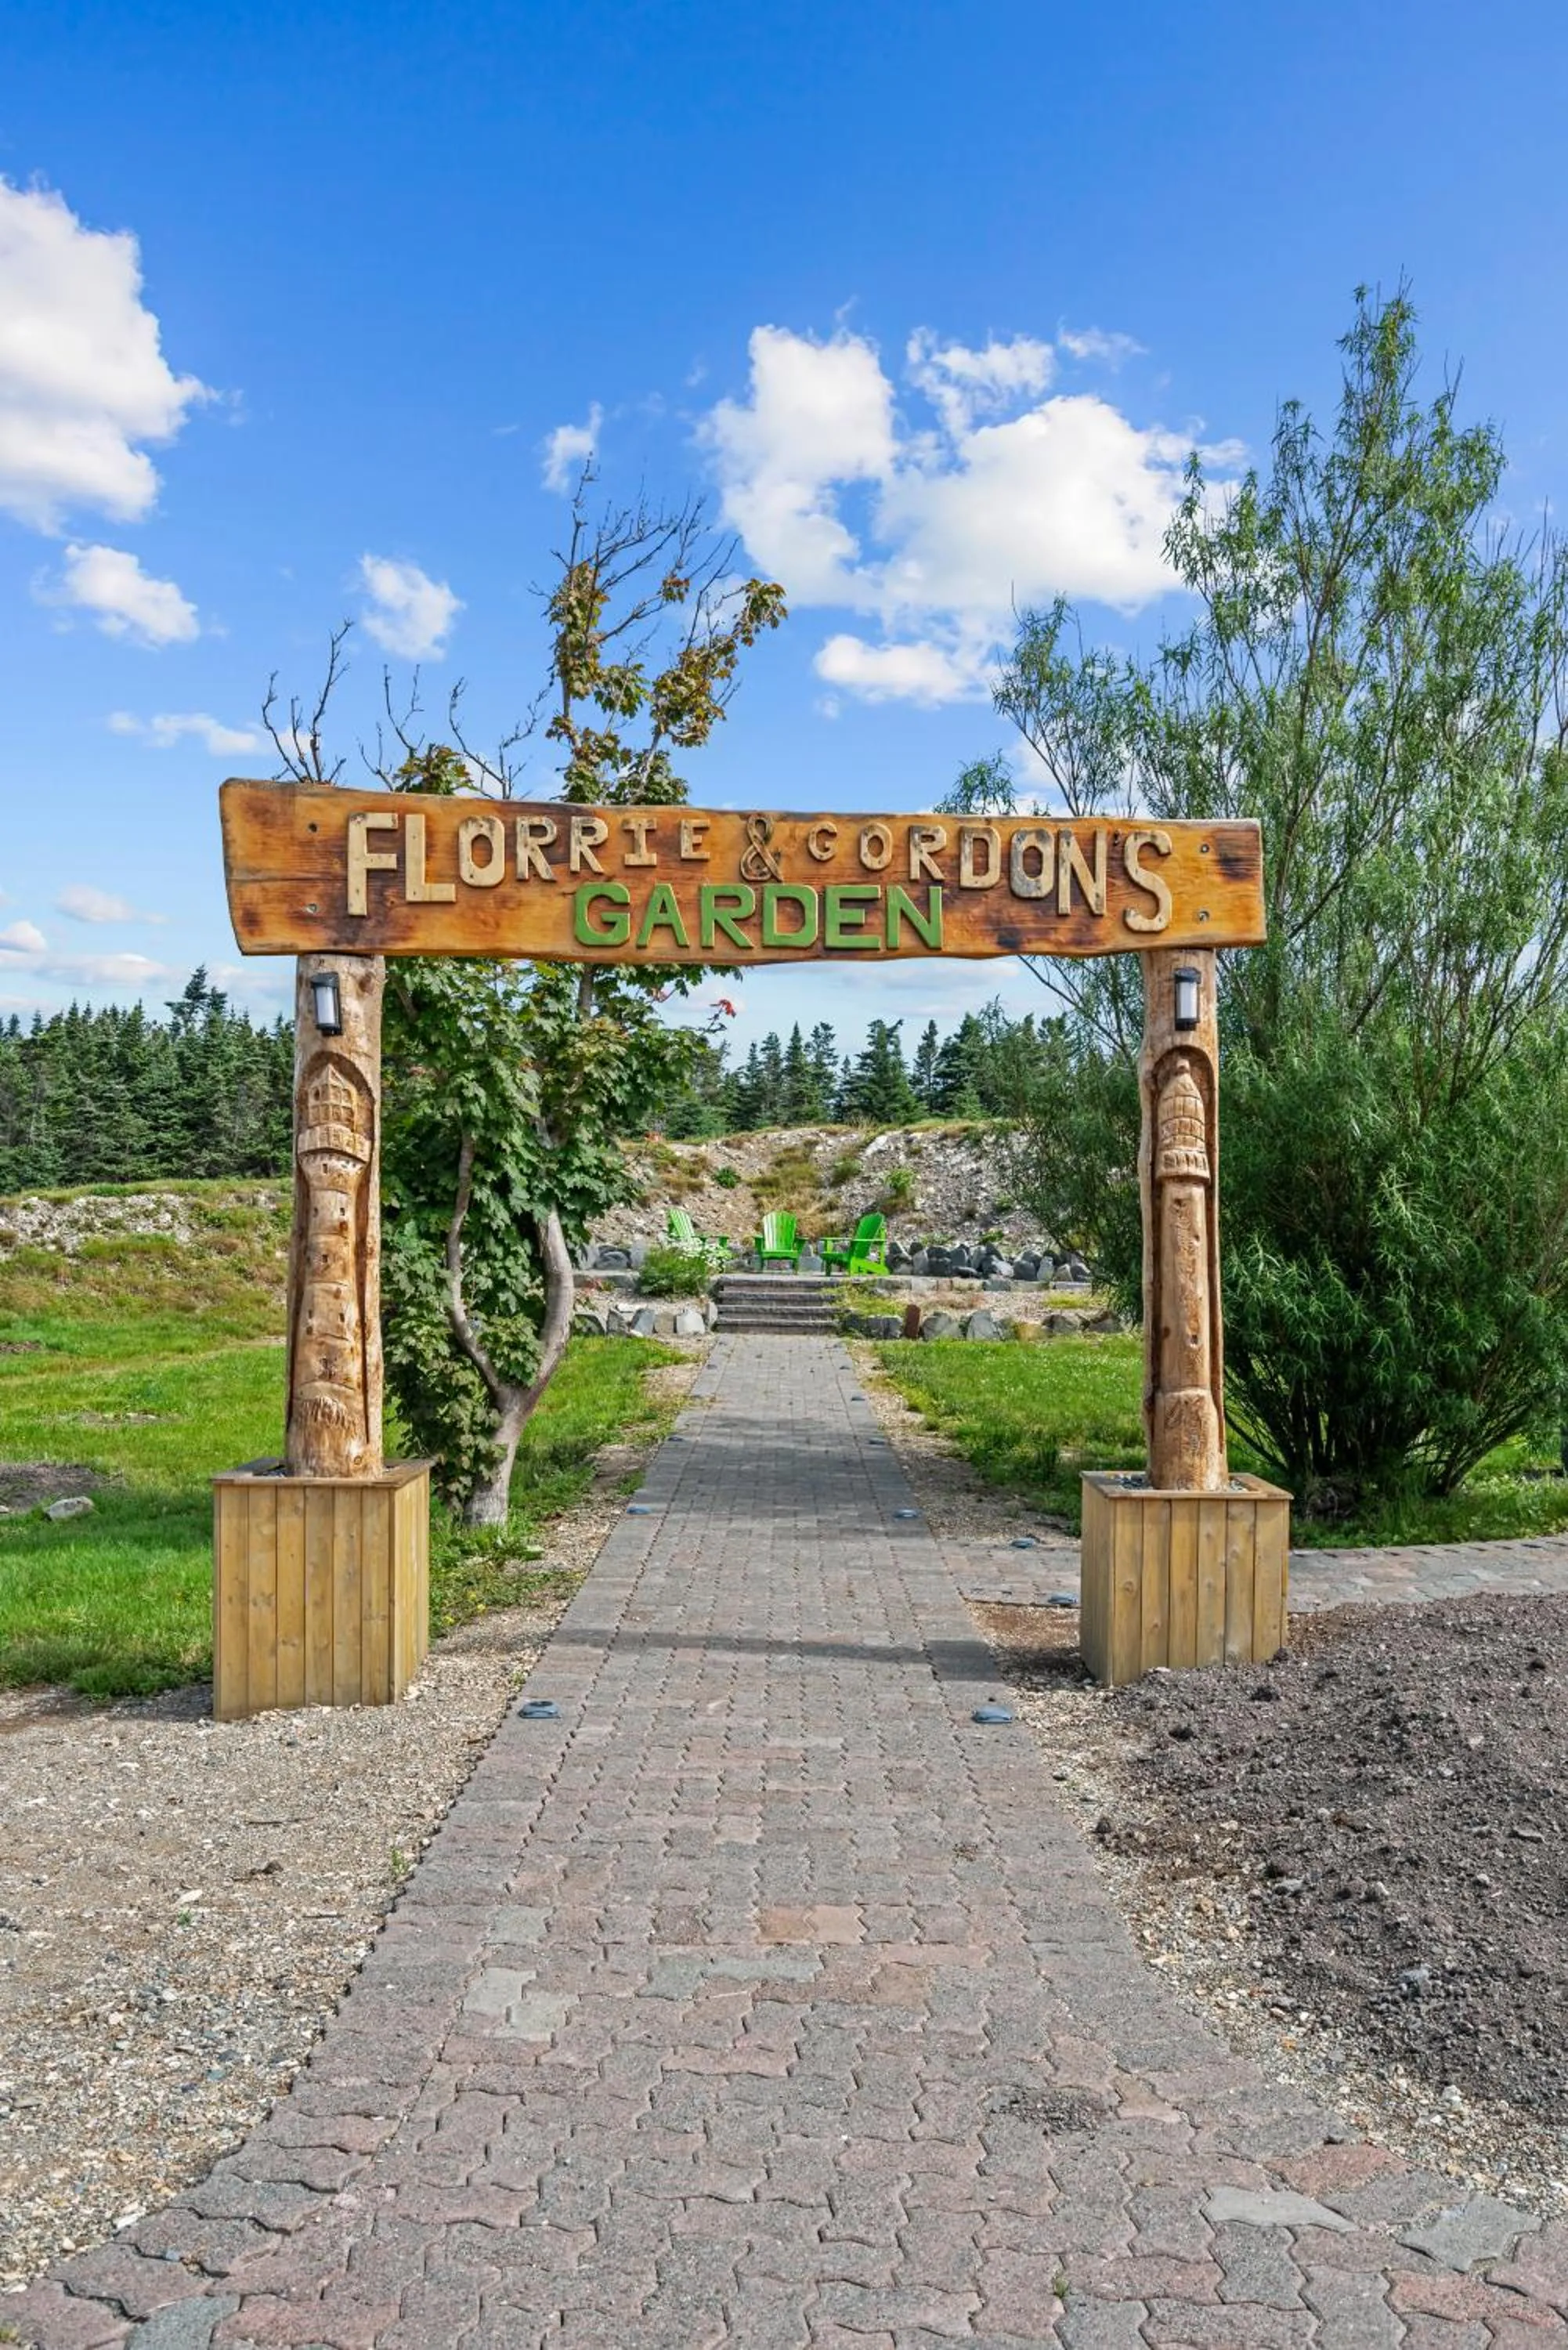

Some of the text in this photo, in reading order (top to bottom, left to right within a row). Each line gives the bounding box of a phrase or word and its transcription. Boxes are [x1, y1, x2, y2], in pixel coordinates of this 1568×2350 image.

[347, 812, 1172, 932] FLORRIE & GORDON'S
[574, 882, 943, 949] GARDEN
